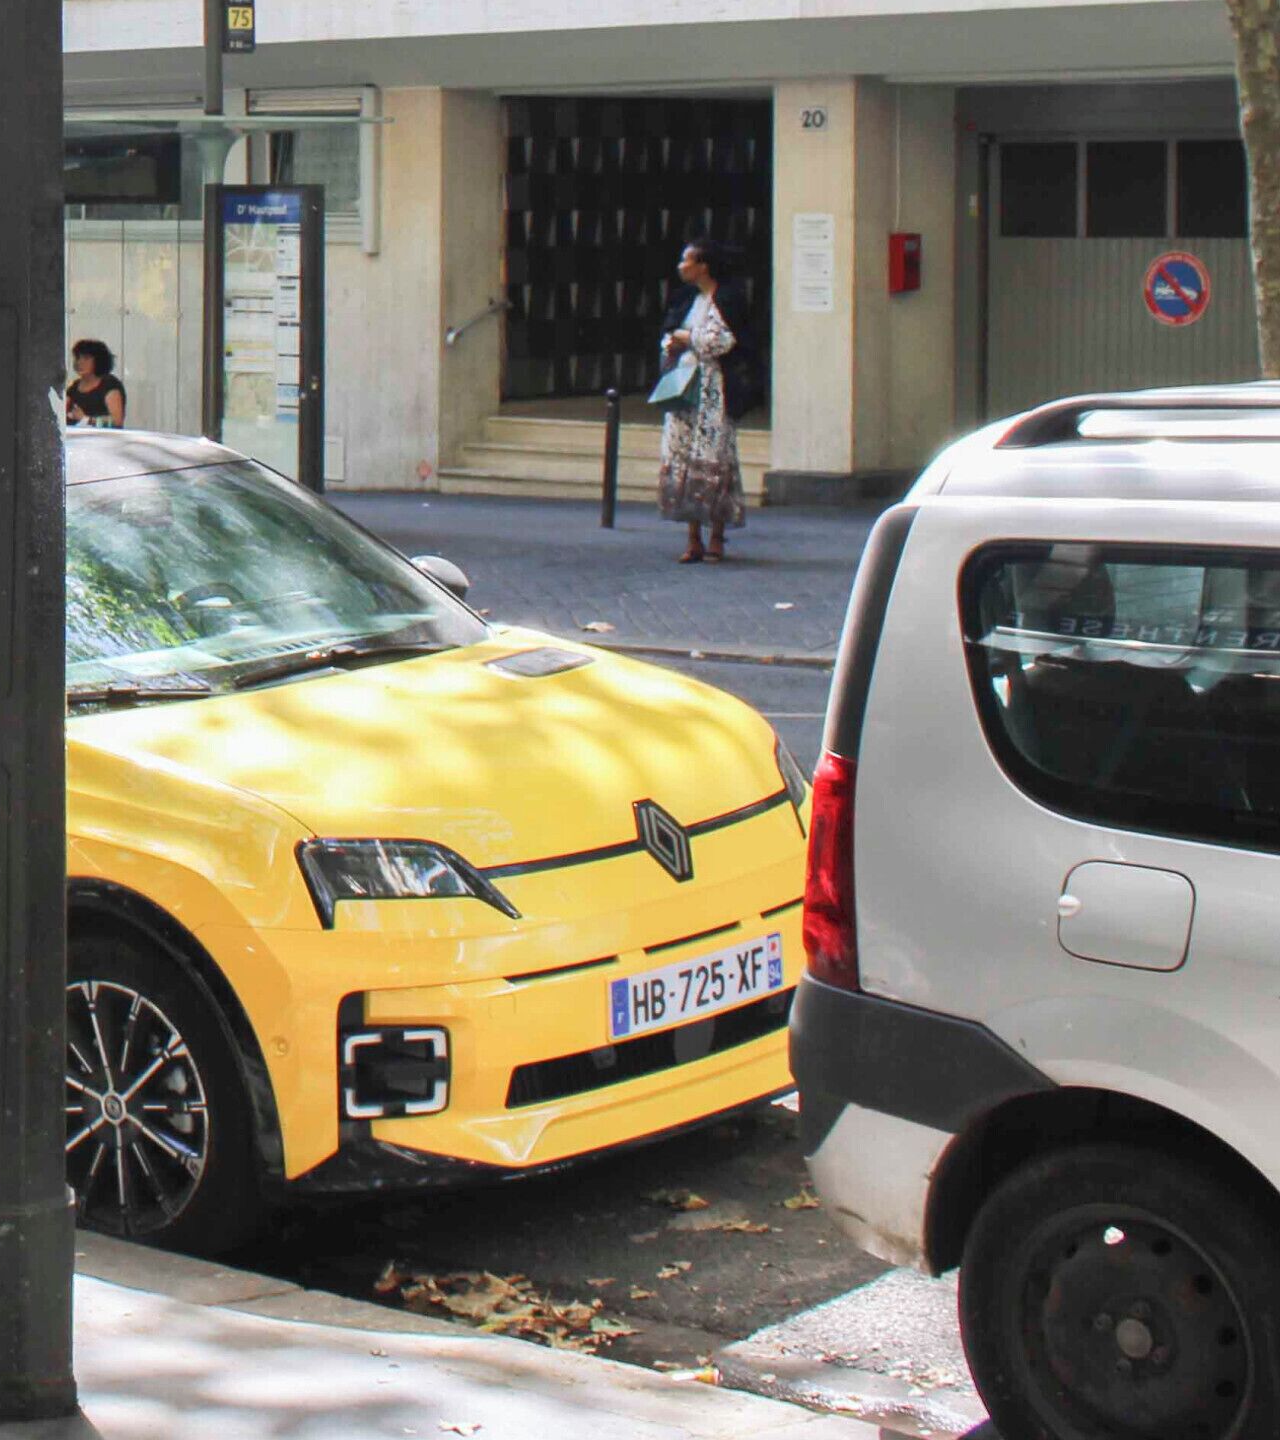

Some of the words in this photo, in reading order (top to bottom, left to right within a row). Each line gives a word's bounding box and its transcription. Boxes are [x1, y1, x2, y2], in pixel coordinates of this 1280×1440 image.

[231, 10, 250, 27] 75
[802, 110, 825, 128] 20
[633, 945, 764, 1026] HB-725-XF
